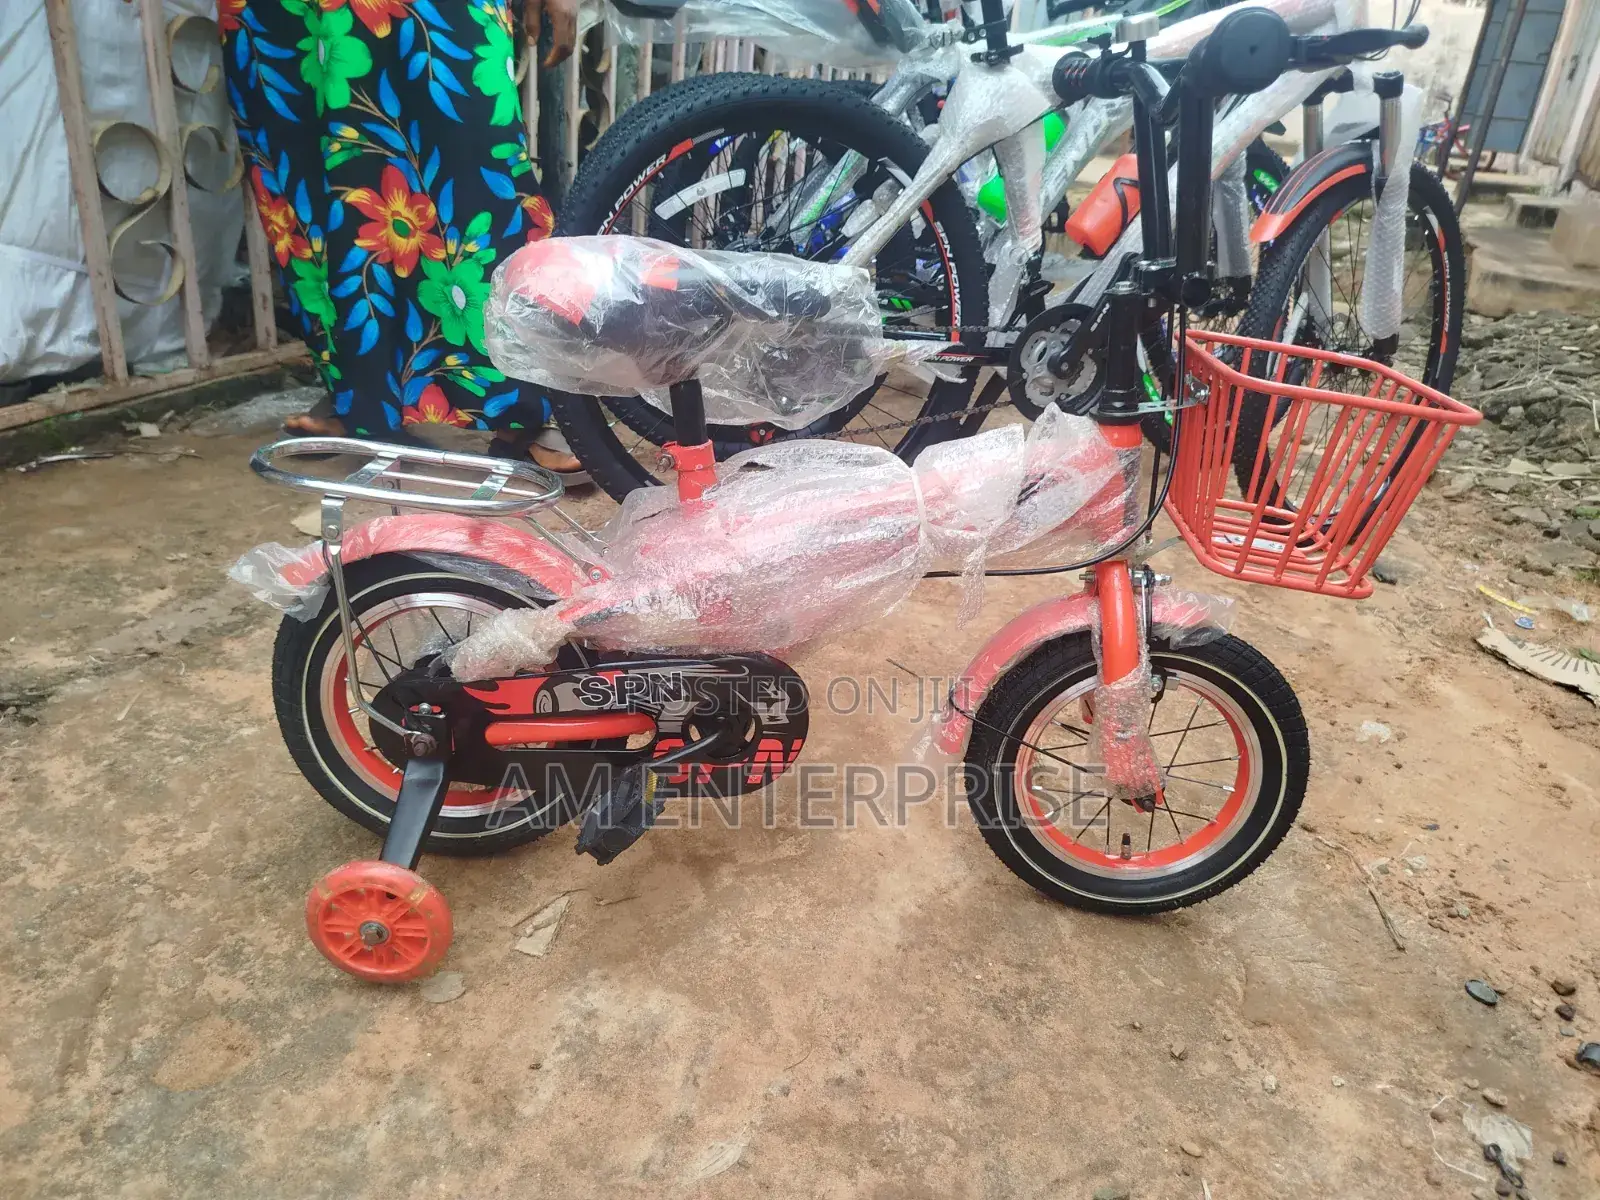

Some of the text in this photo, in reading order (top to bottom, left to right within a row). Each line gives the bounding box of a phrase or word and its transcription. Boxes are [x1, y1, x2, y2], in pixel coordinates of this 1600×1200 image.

[614, 153, 667, 212] POWER
[934, 220, 962, 331] SPN POWER
[941, 355, 975, 363] POWER
[579, 670, 685, 708] SPN
